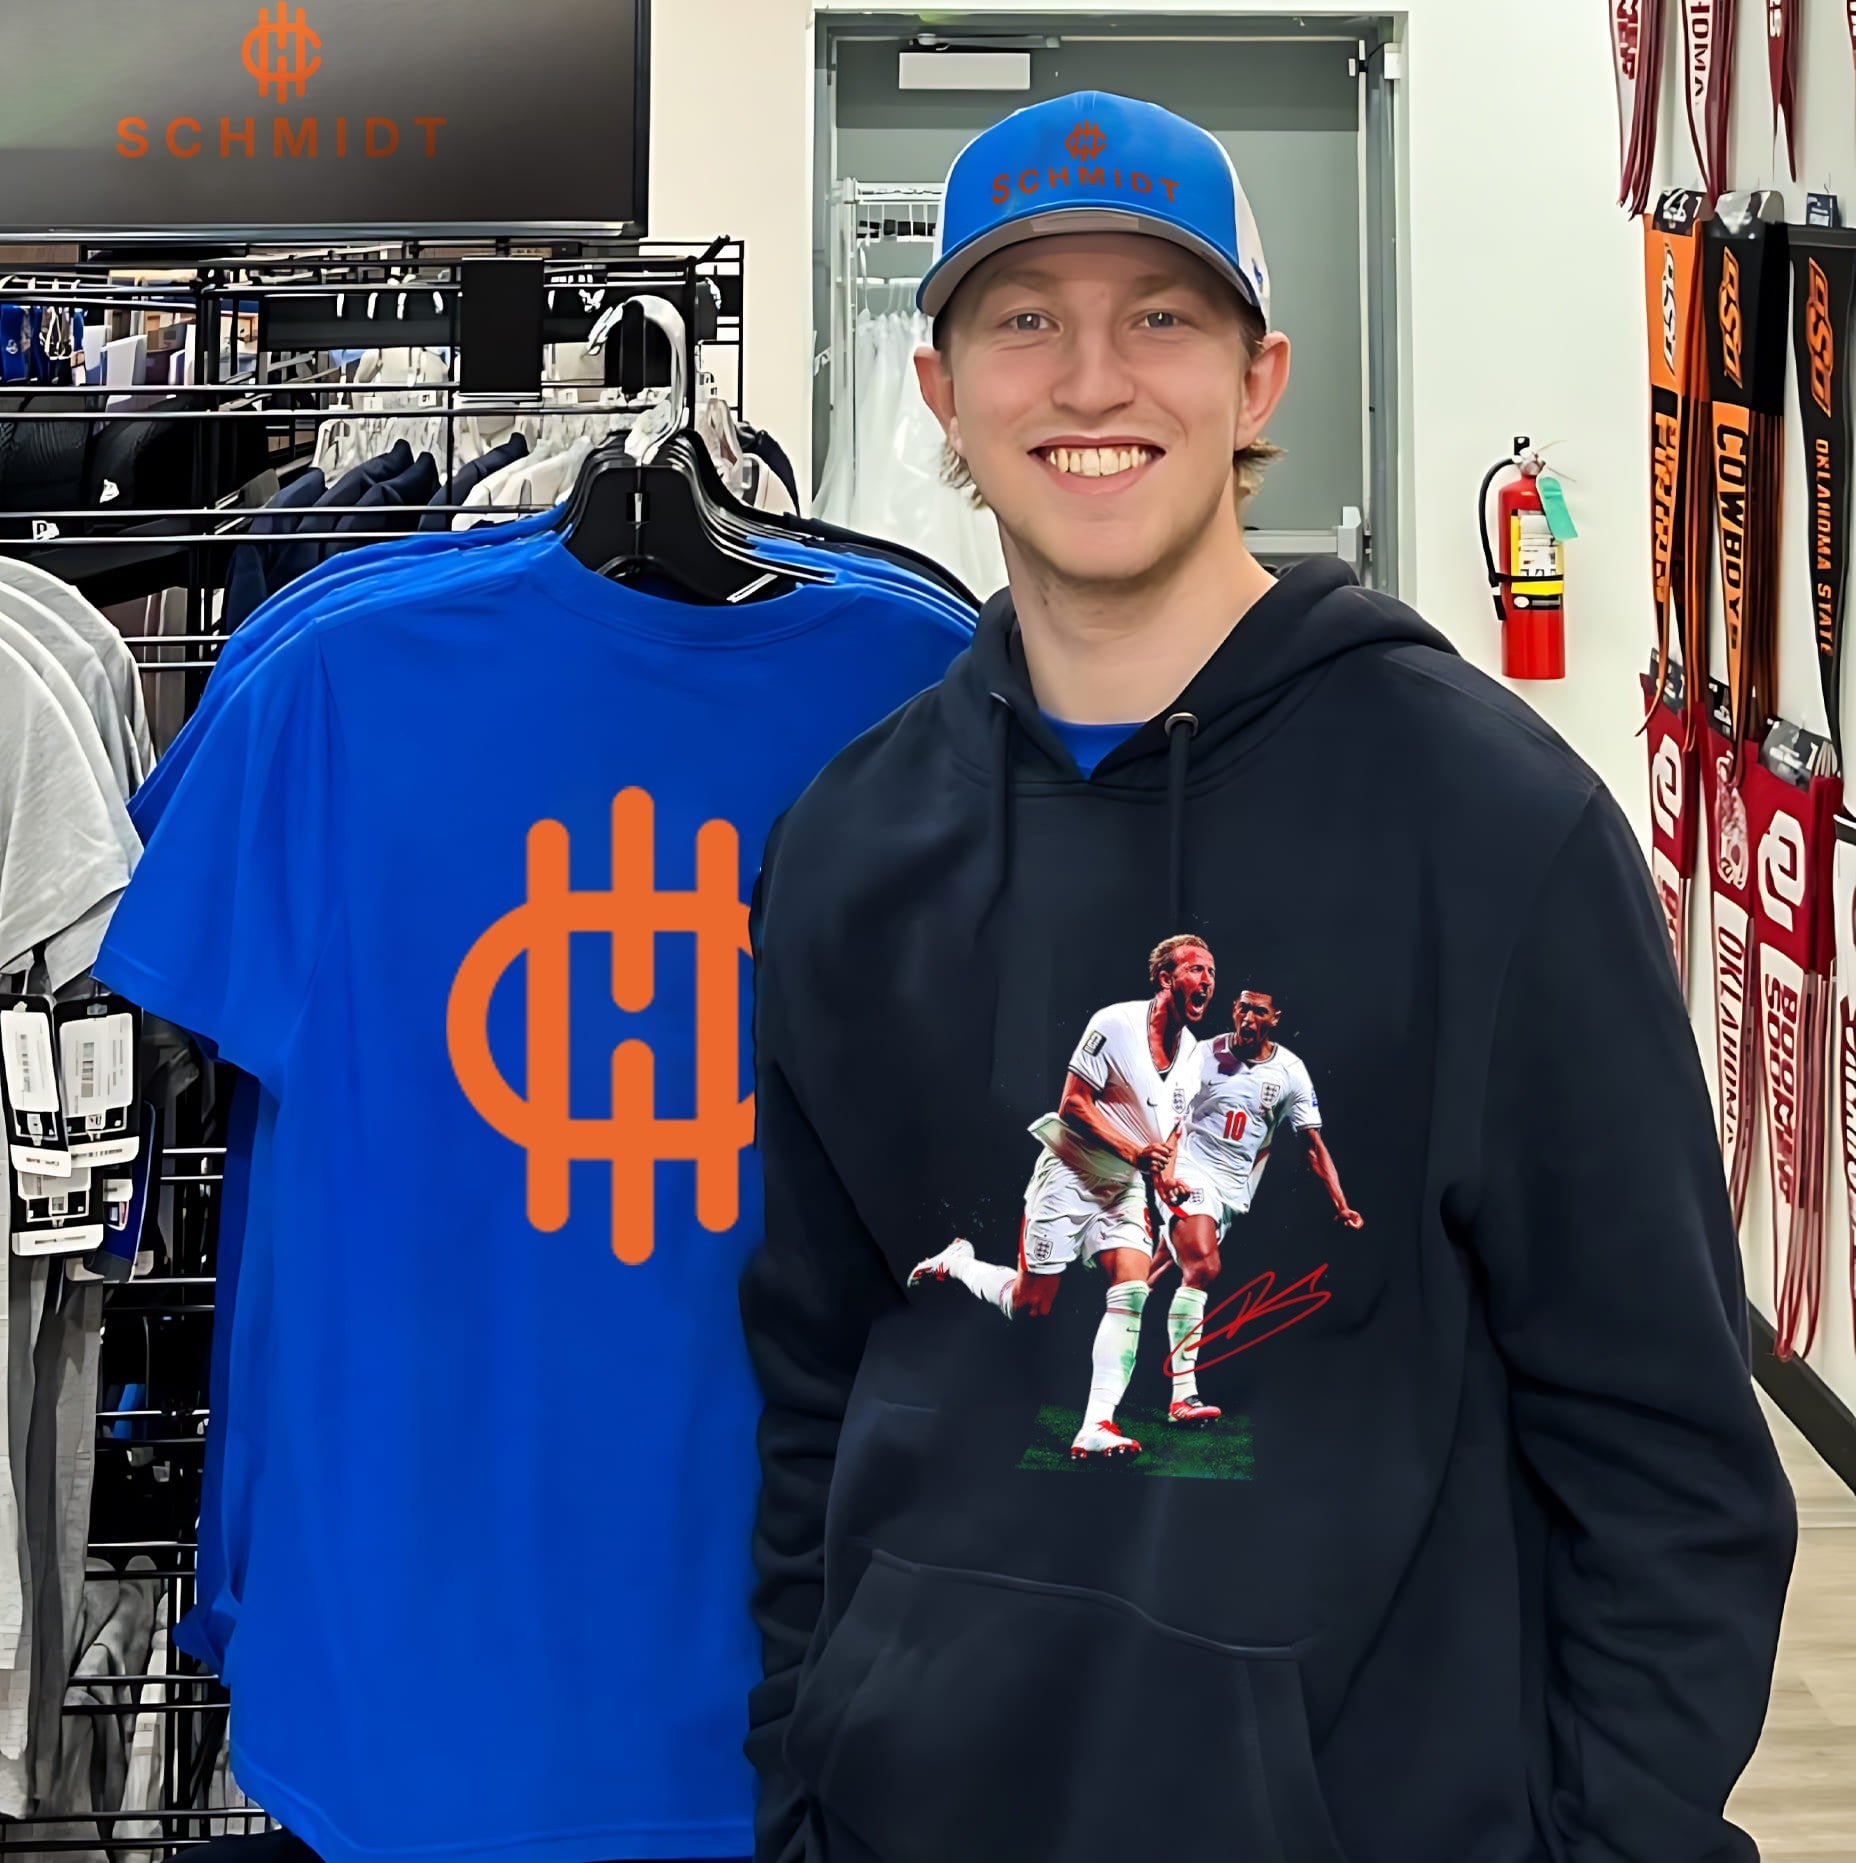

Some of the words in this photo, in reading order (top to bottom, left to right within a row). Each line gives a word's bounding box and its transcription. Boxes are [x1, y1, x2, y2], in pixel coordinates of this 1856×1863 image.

[115, 116, 447, 159] SCHMIDT
[991, 166, 1179, 205] SCHMIDT
[1814, 438, 1833, 571] OKLAHOMA
[1717, 925, 1746, 1144] OKLAHOMA
[1223, 1110, 1247, 1141] 10
